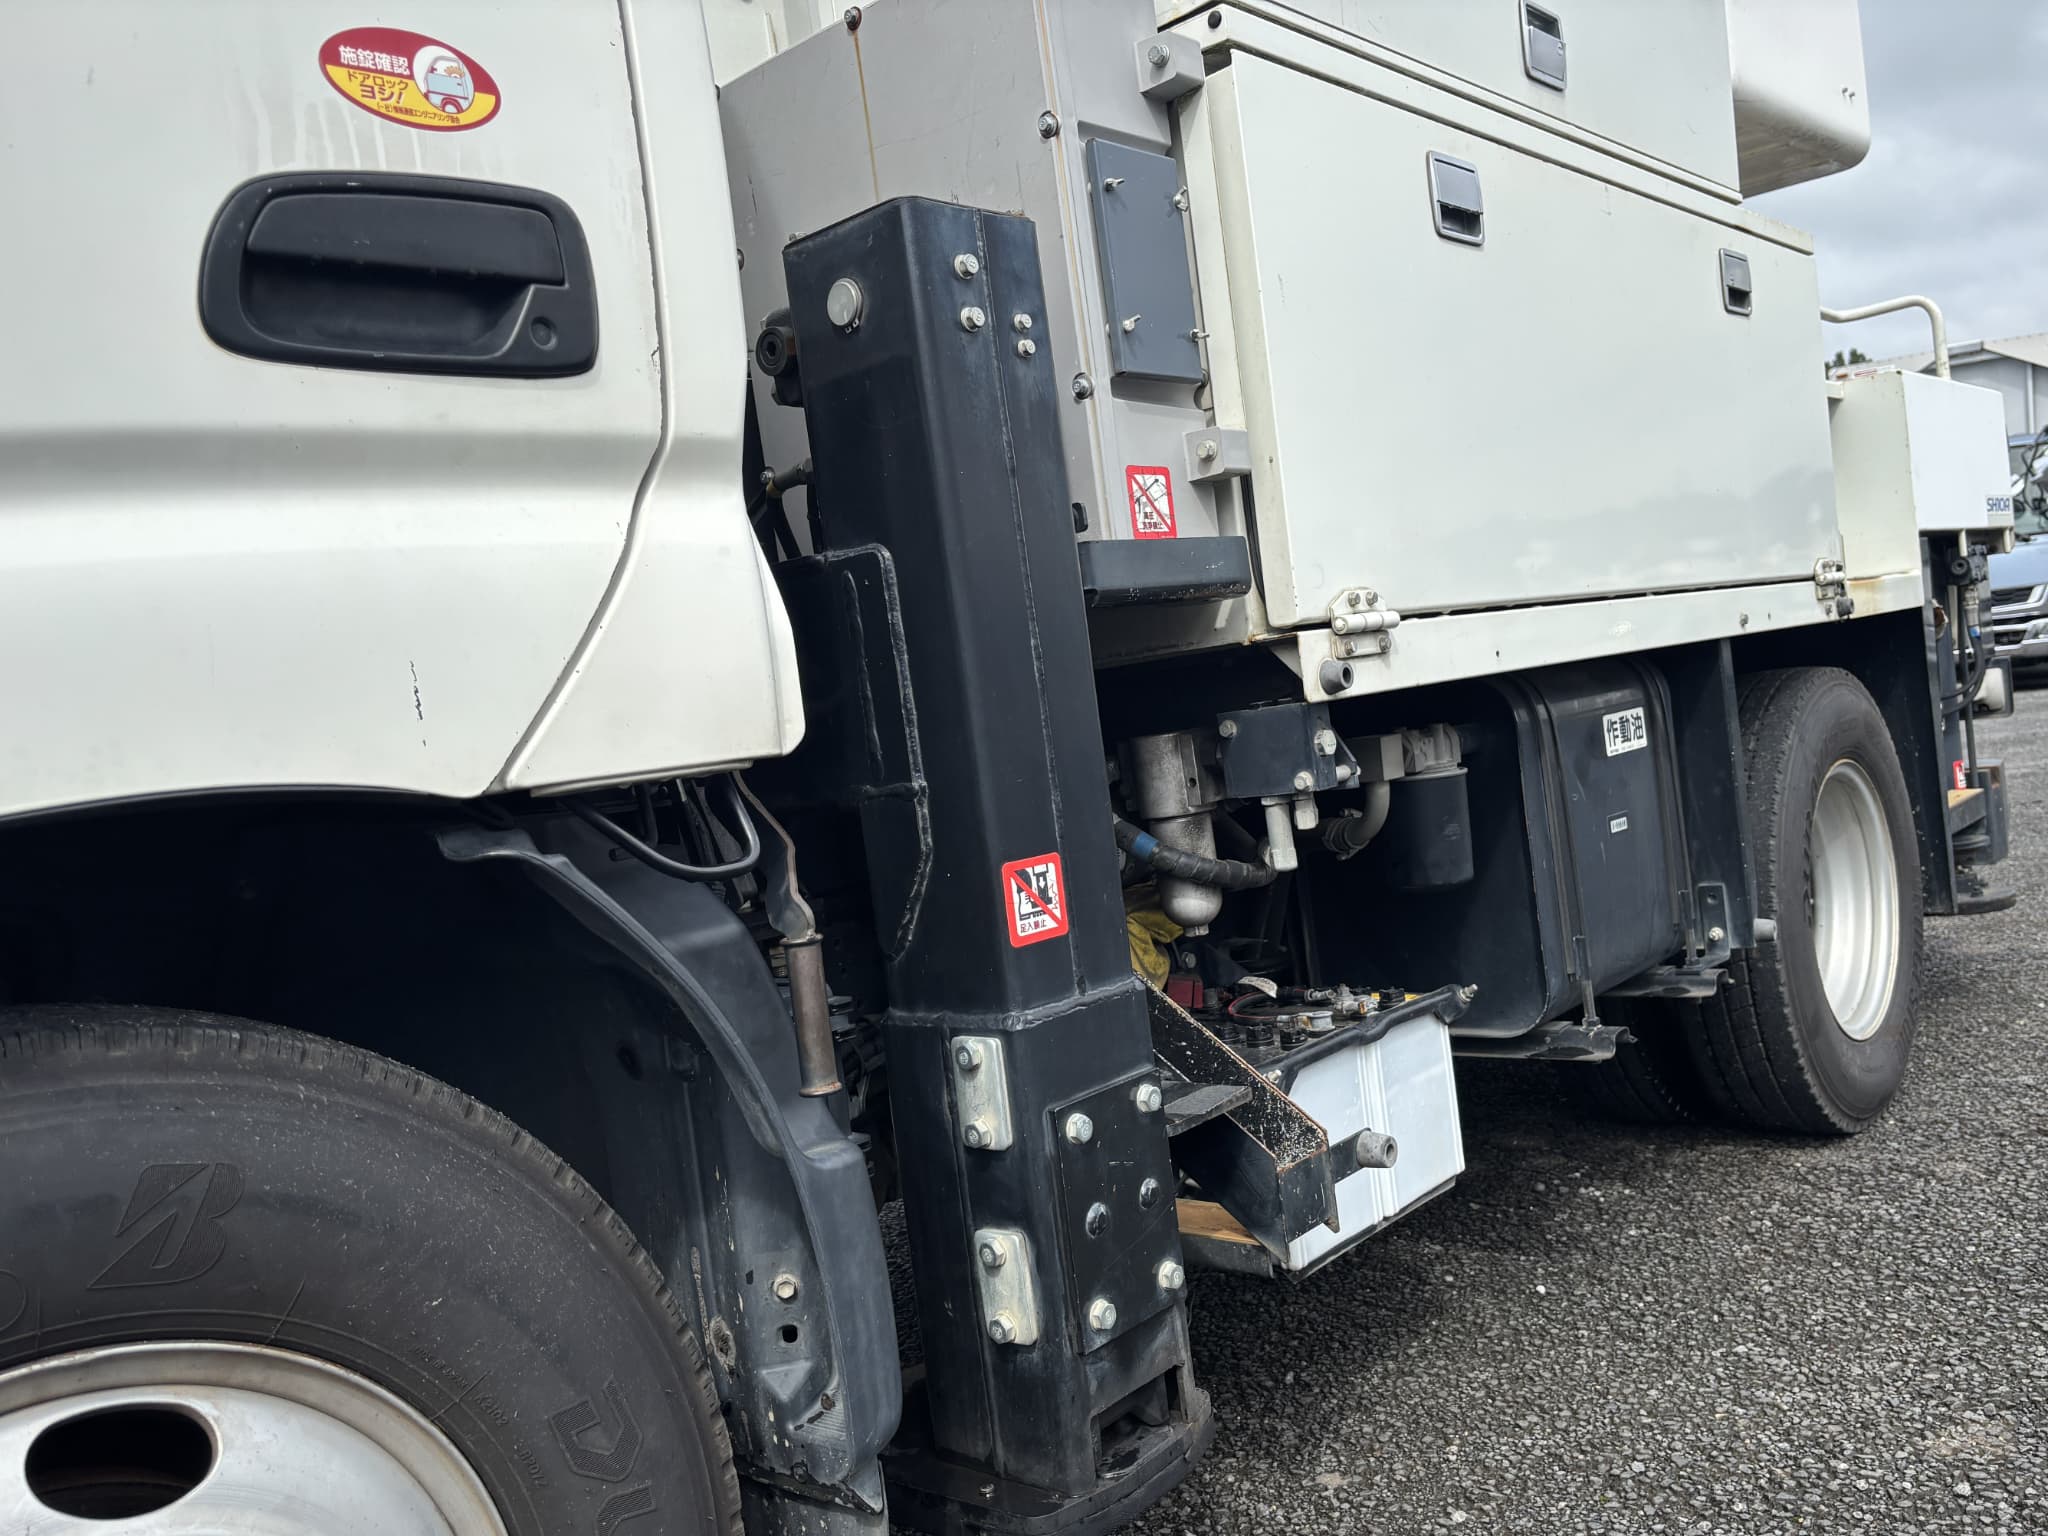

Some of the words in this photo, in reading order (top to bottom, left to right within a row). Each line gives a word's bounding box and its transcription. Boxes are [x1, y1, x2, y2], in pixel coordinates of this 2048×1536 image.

[338, 45, 410, 75] 施錠確認
[347, 70, 409, 91] ドアロック
[1606, 712, 1644, 748] 作動油
